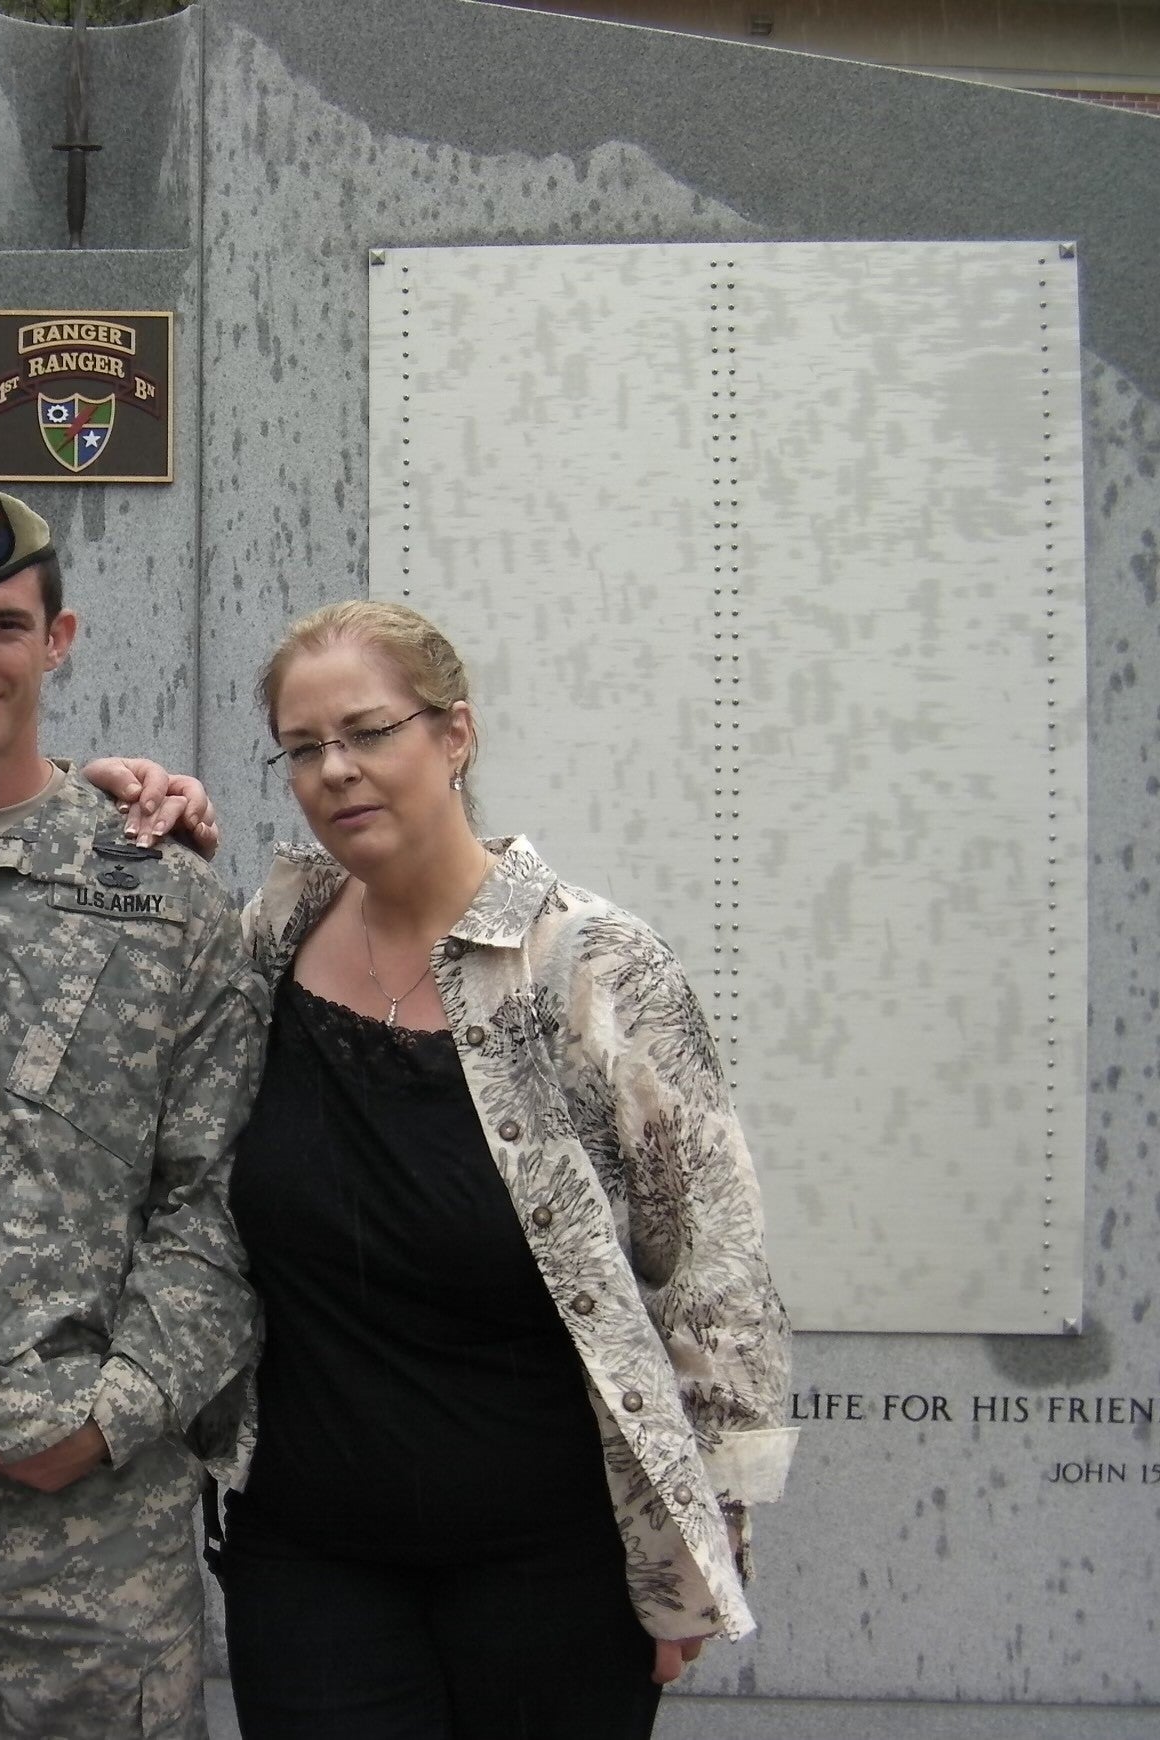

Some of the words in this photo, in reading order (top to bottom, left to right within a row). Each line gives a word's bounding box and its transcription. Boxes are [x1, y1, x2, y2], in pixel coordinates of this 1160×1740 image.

[32, 324, 123, 345] RANGER
[28, 352, 126, 378] RANGER
[110, 893, 164, 912] ARMY
[790, 1393, 863, 1420] LIFE
[882, 1394, 952, 1422] FOR
[972, 1396, 1030, 1423] HIS
[1048, 1396, 1160, 1424] FRIEN
[1047, 1462, 1126, 1484] JOHN
